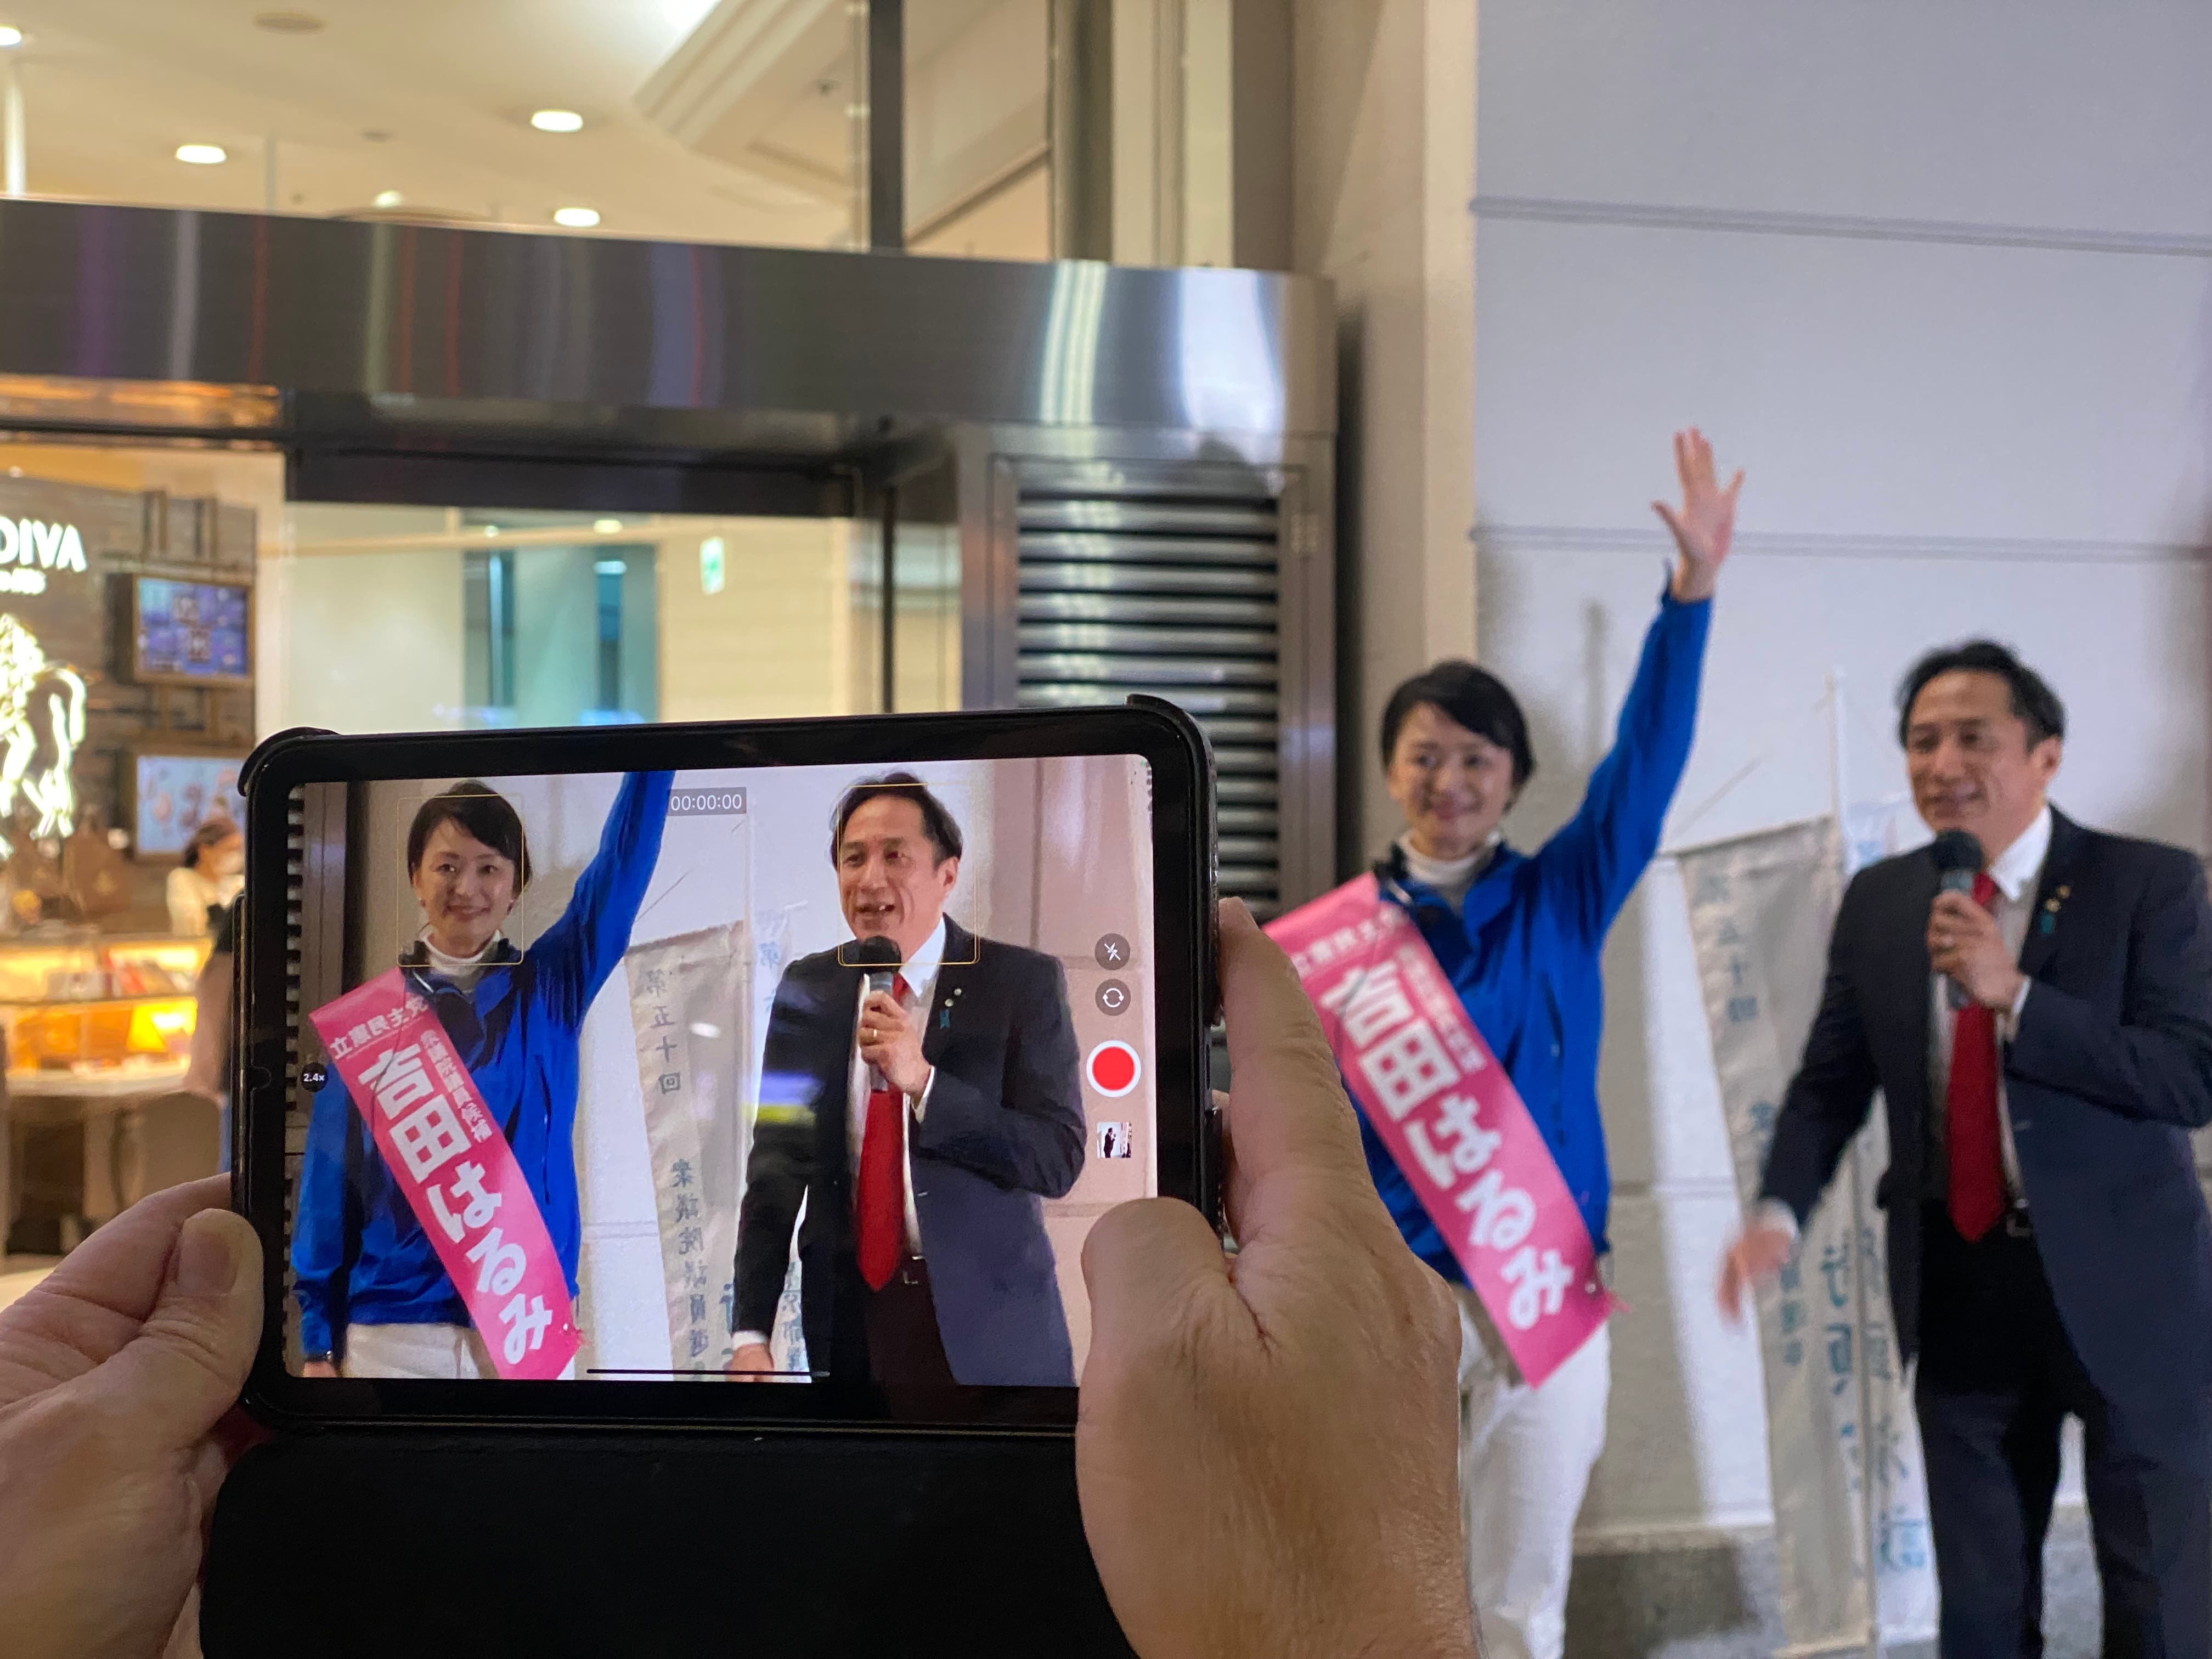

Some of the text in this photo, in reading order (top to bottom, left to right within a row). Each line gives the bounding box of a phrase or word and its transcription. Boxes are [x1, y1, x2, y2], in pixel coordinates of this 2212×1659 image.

[670, 794, 742, 811] 00:00:00
[303, 1073, 325, 1082] 2.4x
[358, 1042, 552, 1365] 吉田はるみ
